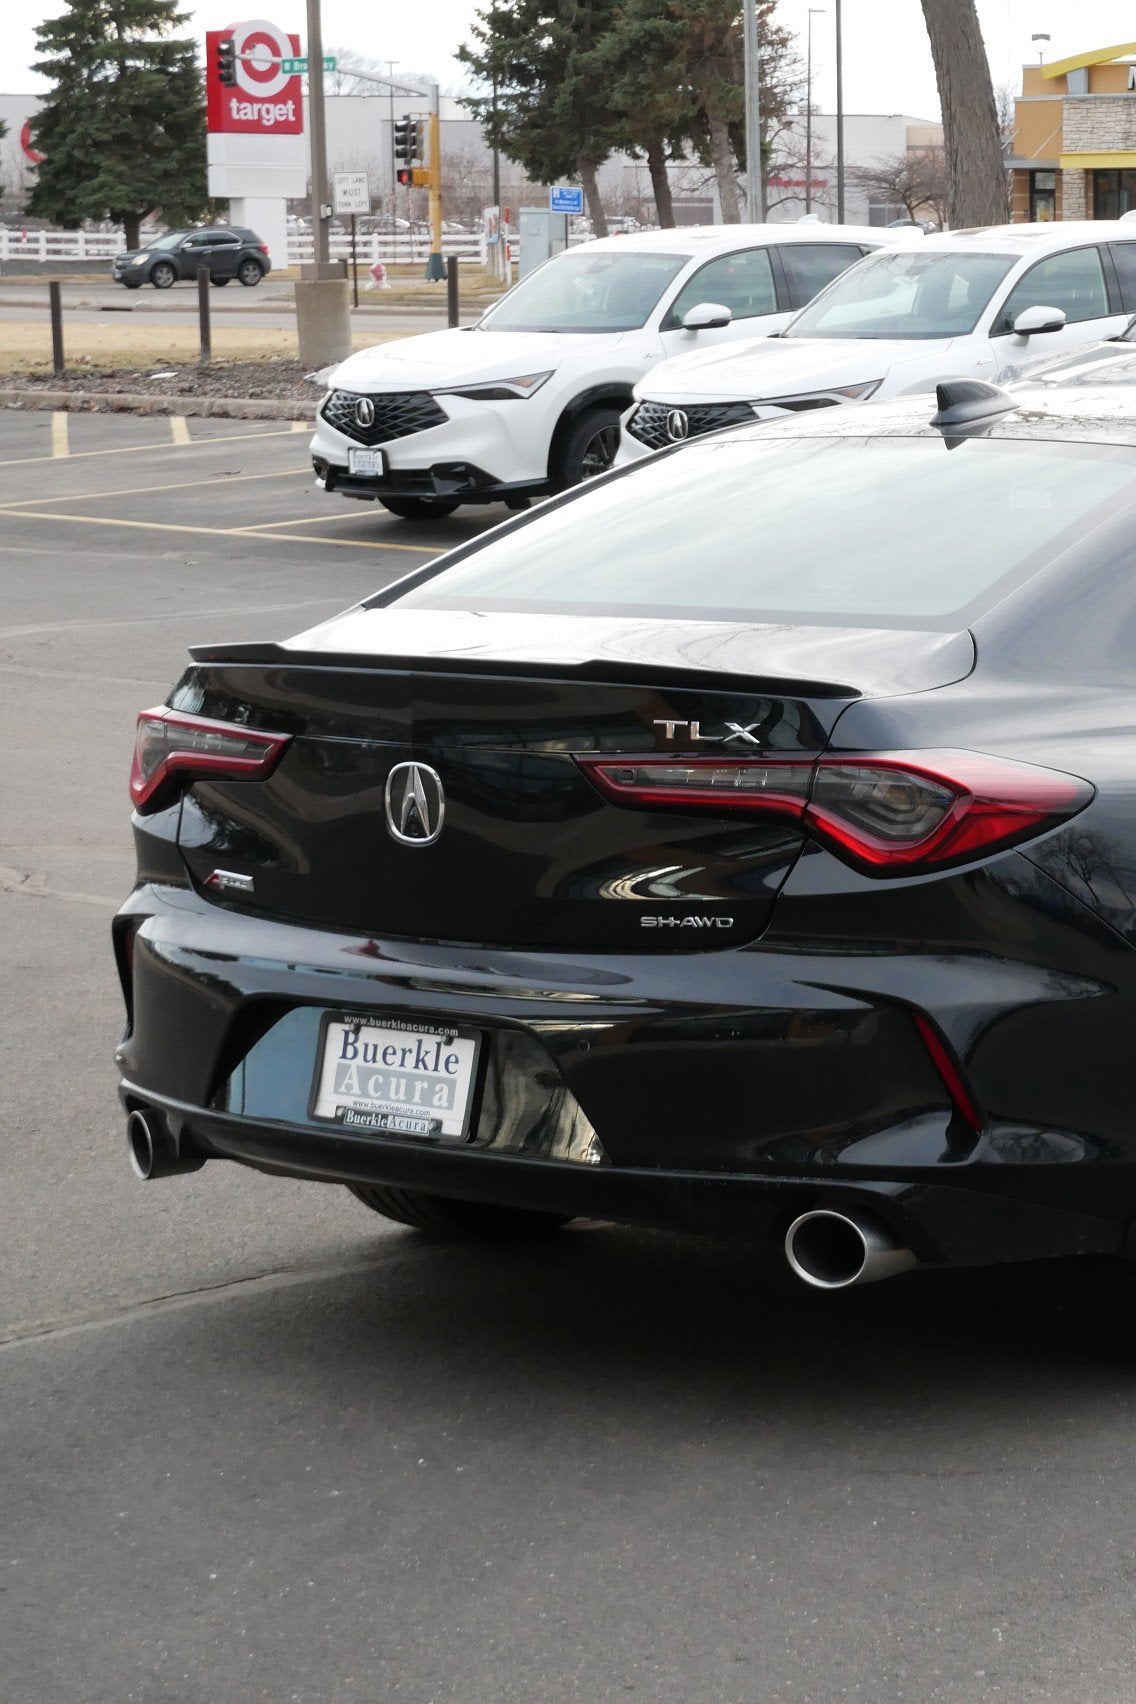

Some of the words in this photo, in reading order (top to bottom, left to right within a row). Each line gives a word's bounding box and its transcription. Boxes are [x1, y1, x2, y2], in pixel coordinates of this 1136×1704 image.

[229, 98, 296, 126] target
[343, 188, 361, 196] MUST
[356, 200, 368, 208] LEFT
[653, 719, 761, 744] TLX
[344, 1014, 459, 1037] www.buerkleacura.com
[338, 1028, 460, 1075] Buerkle
[338, 1066, 449, 1108] Acura
[353, 1099, 431, 1117] www.buerkleacura.com
